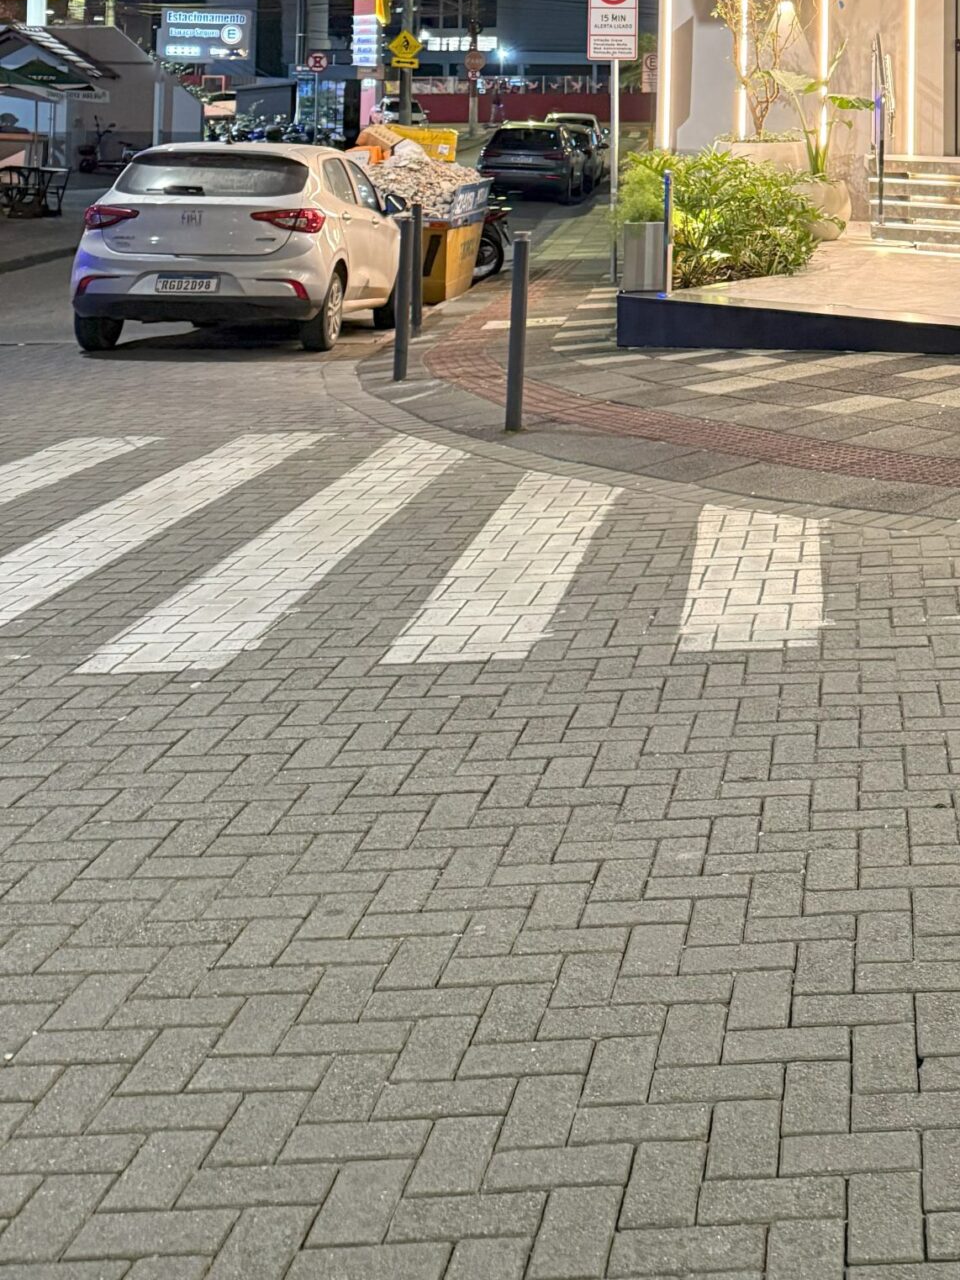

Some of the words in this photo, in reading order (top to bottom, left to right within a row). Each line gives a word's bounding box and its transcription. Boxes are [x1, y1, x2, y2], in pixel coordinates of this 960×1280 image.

[167, 11, 246, 24] Estacionamento
[601, 14, 609, 22] 15
[611, 14, 626, 22] MIN
[227, 28, 237, 40] E
[181, 211, 204, 226] FIAT
